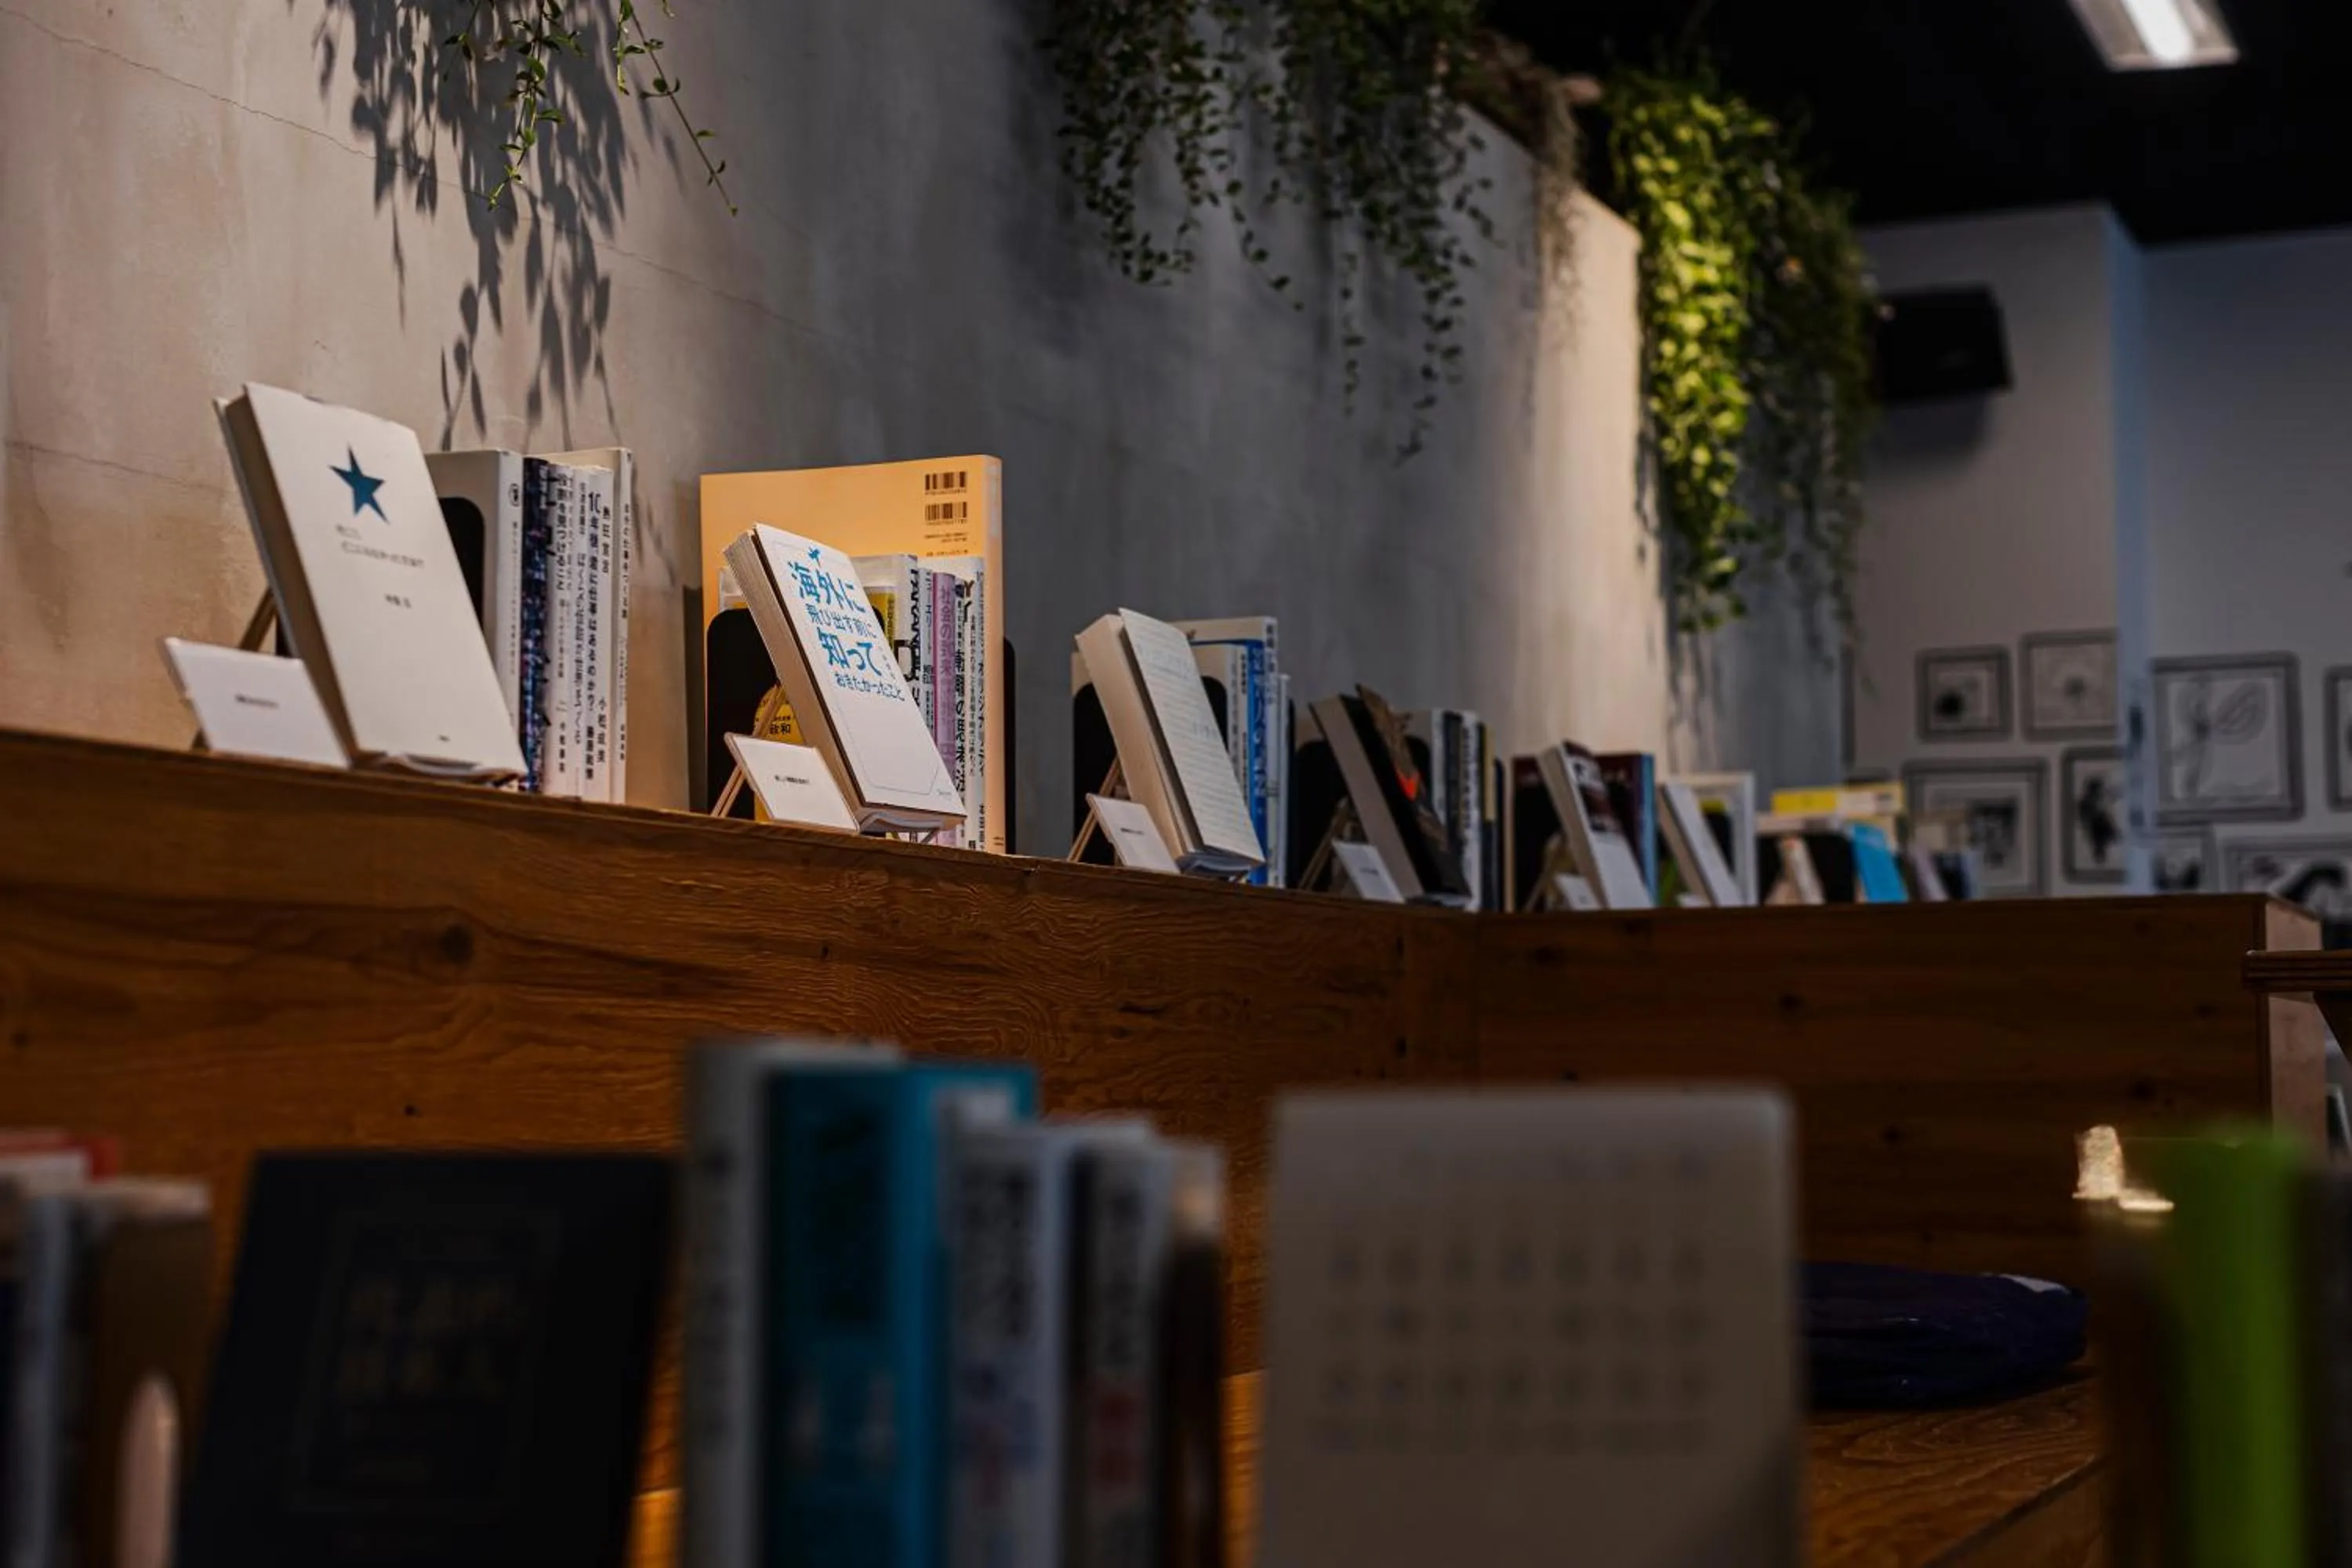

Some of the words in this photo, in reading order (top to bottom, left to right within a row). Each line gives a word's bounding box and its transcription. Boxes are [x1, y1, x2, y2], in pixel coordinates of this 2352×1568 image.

[787, 561, 866, 613] 海外に
[816, 627, 882, 677] 知って
[834, 672, 906, 702] おきたかったこと
